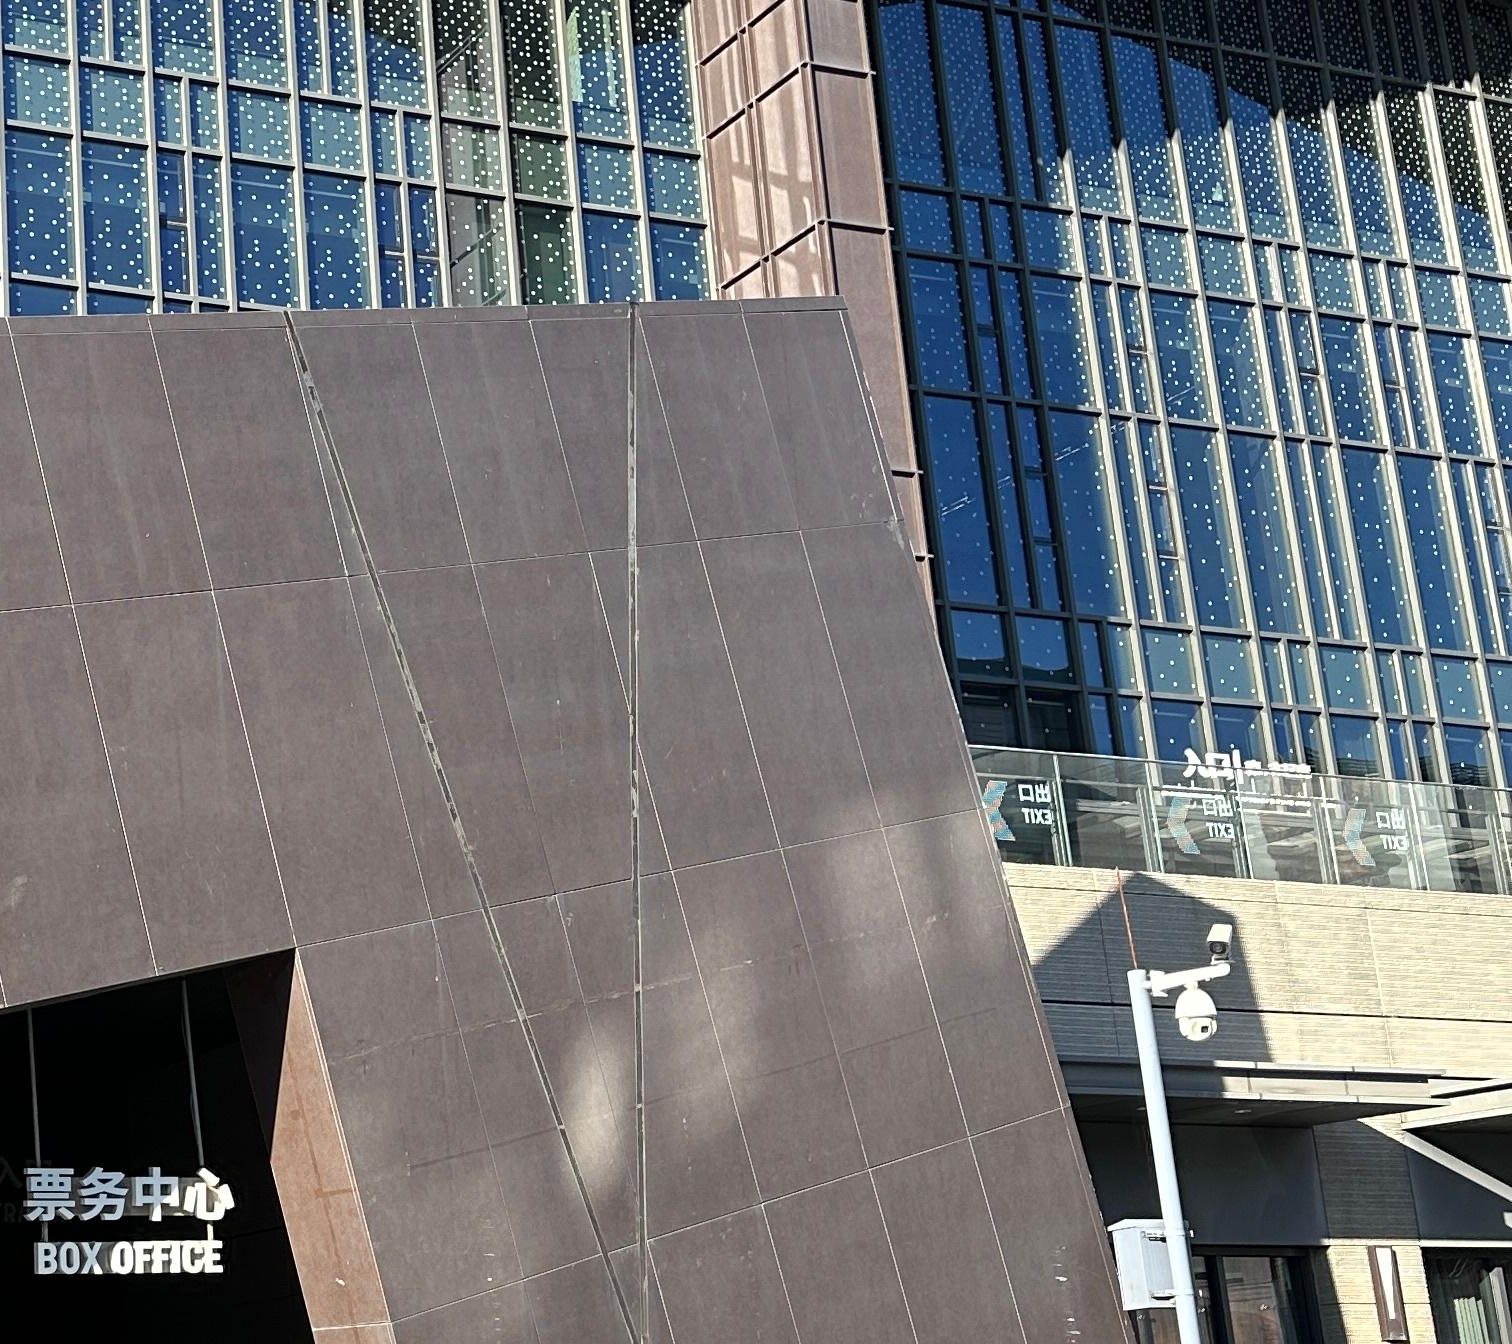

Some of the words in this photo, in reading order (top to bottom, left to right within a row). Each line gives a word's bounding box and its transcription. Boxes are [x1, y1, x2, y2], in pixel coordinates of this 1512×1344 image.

[24, 1167, 234, 1222] 票务中心
[34, 1240, 102, 1274] BOX
[109, 1240, 224, 1274] OFFICE
